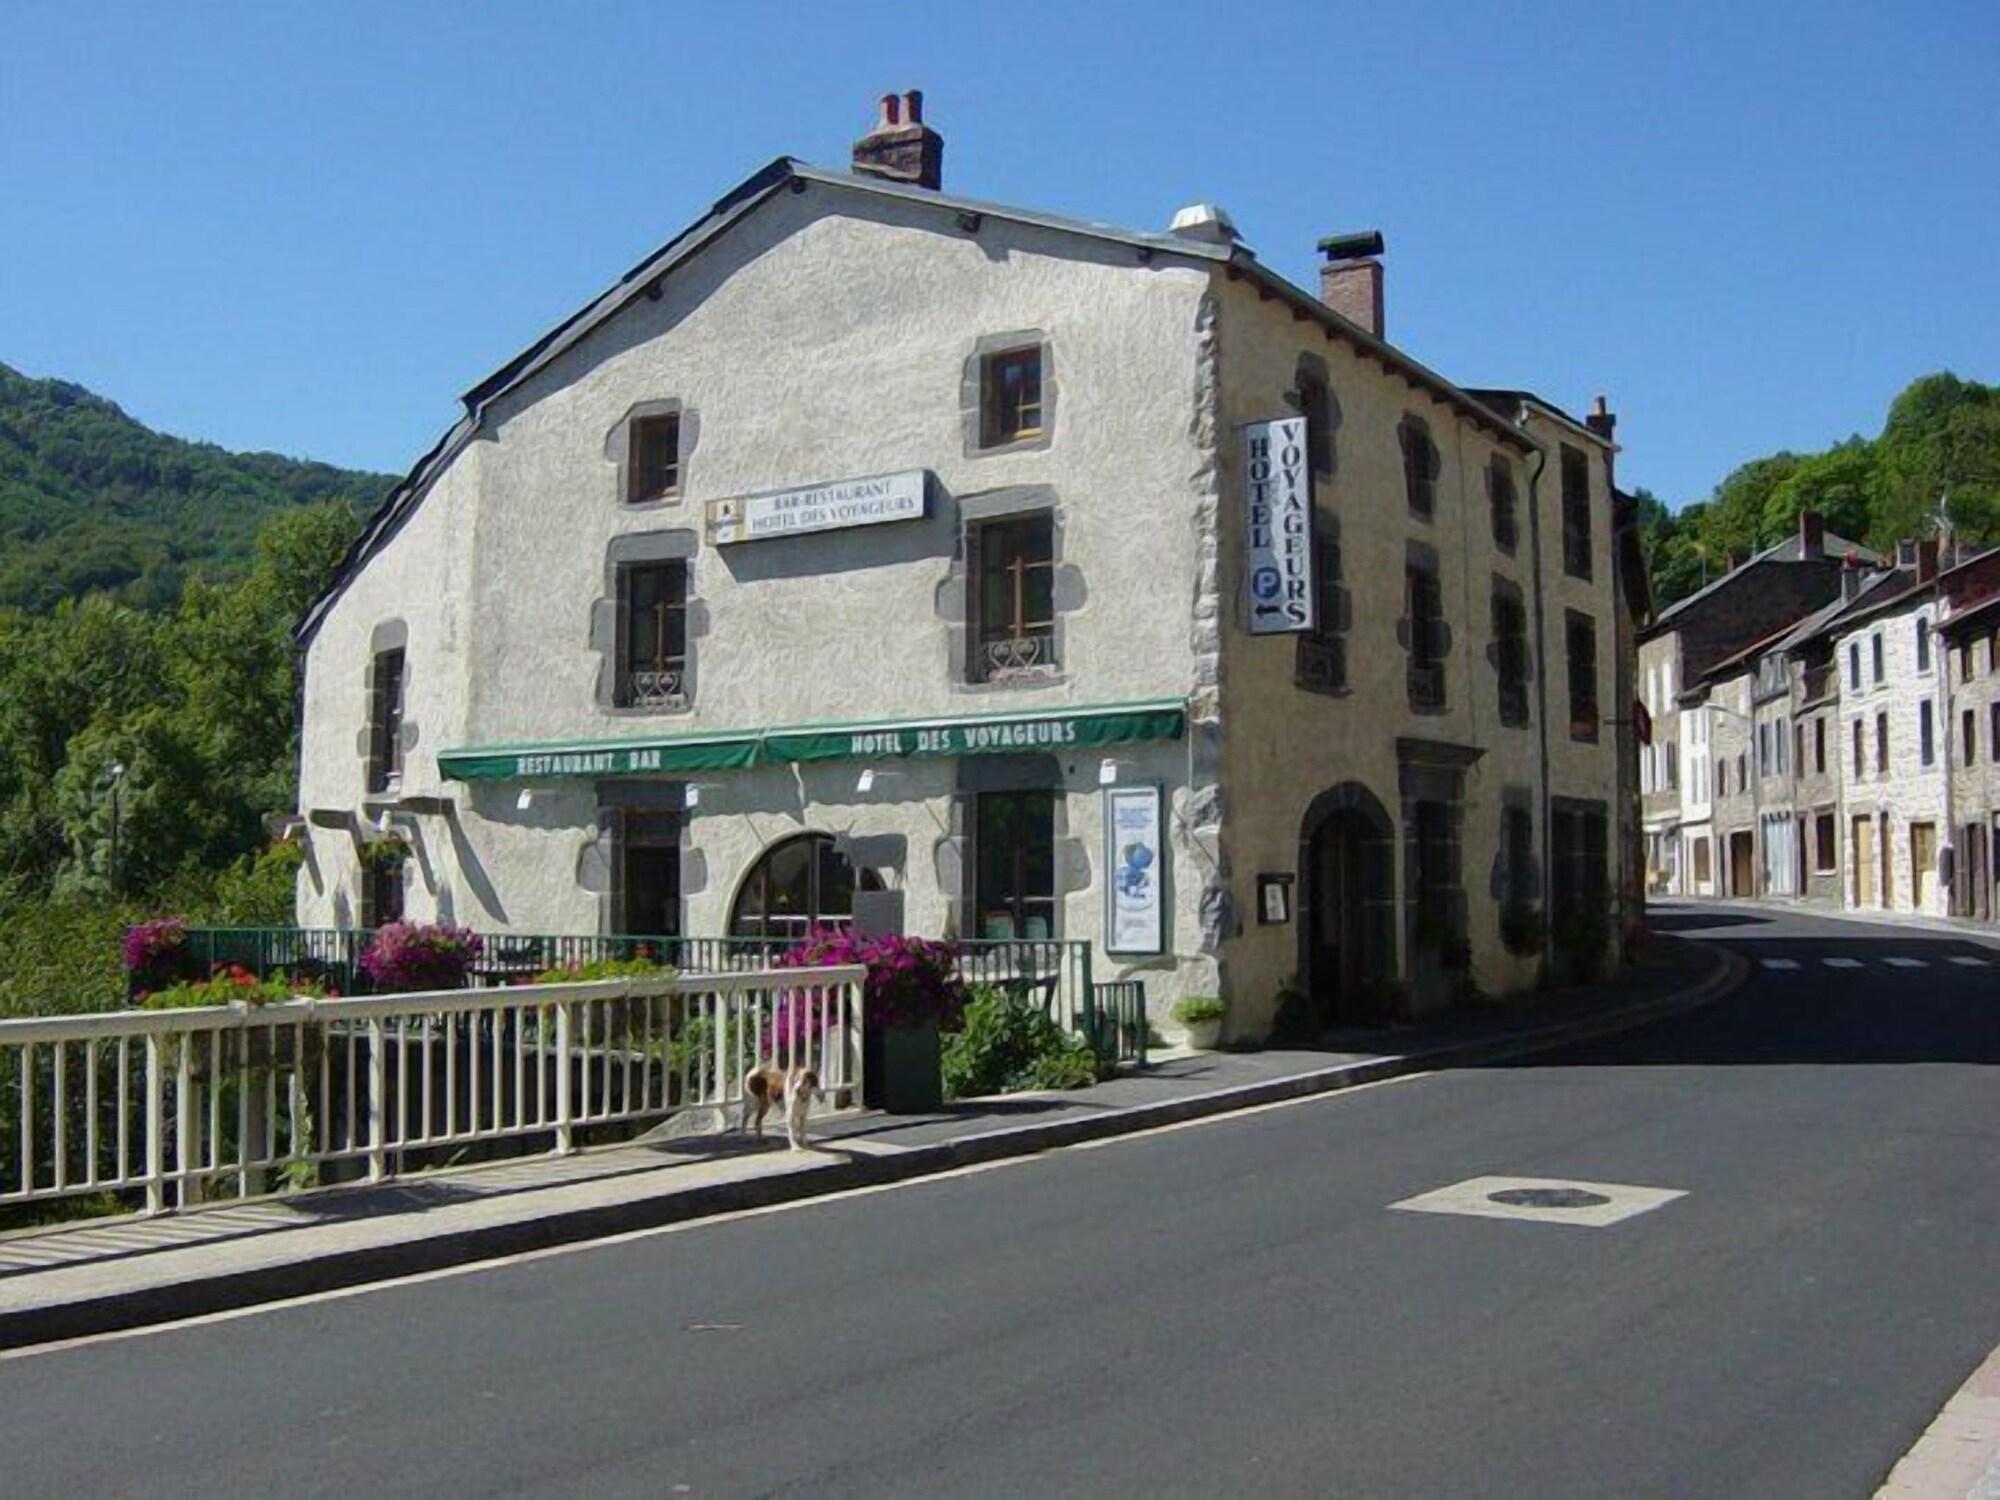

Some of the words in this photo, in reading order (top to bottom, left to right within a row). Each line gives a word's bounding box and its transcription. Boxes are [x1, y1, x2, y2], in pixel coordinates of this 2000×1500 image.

[1250, 438, 1271, 548] HOTEL
[800, 509, 826, 526] DES
[829, 496, 914, 521] VOYAGEURS
[1281, 422, 1306, 624] VOYAGEURS
[851, 733, 902, 753] HOTEL
[916, 729, 950, 750] DES
[964, 721, 1076, 748] VOYAGEURS
[516, 752, 614, 775] RESTAURANT
[629, 750, 661, 770] BAR
